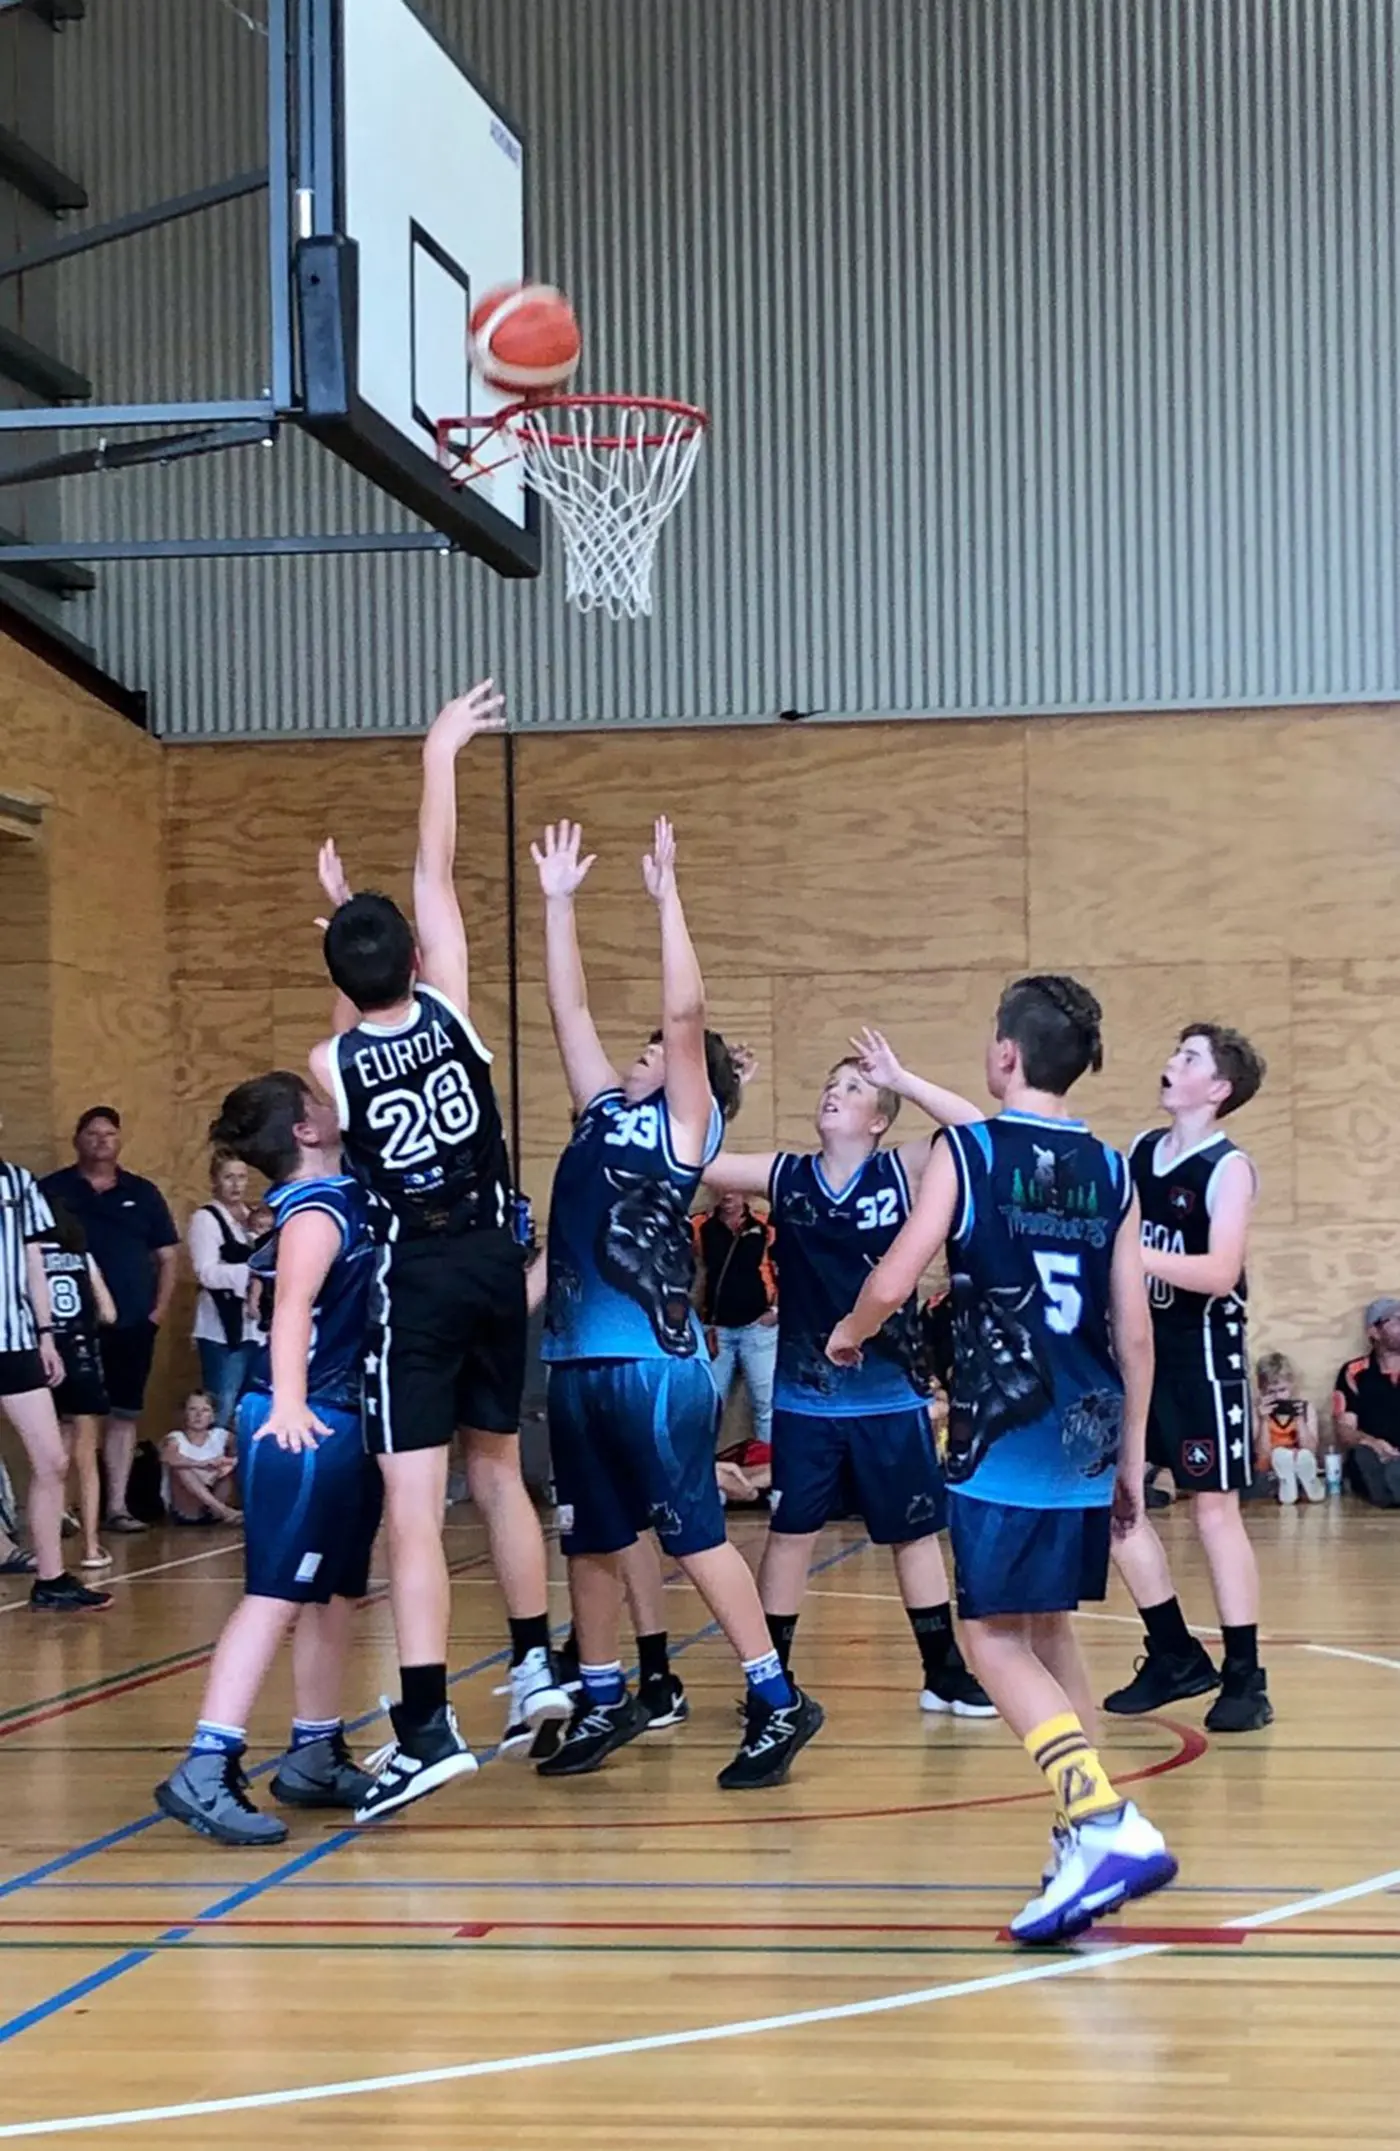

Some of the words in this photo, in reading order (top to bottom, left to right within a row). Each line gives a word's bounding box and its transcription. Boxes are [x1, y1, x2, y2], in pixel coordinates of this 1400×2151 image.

[366, 1059, 481, 1170] 28
[604, 1105, 658, 1150] 33
[856, 1188, 899, 1230] 32
[48, 1275, 82, 1317] 8
[1032, 1250, 1083, 1335] 5
